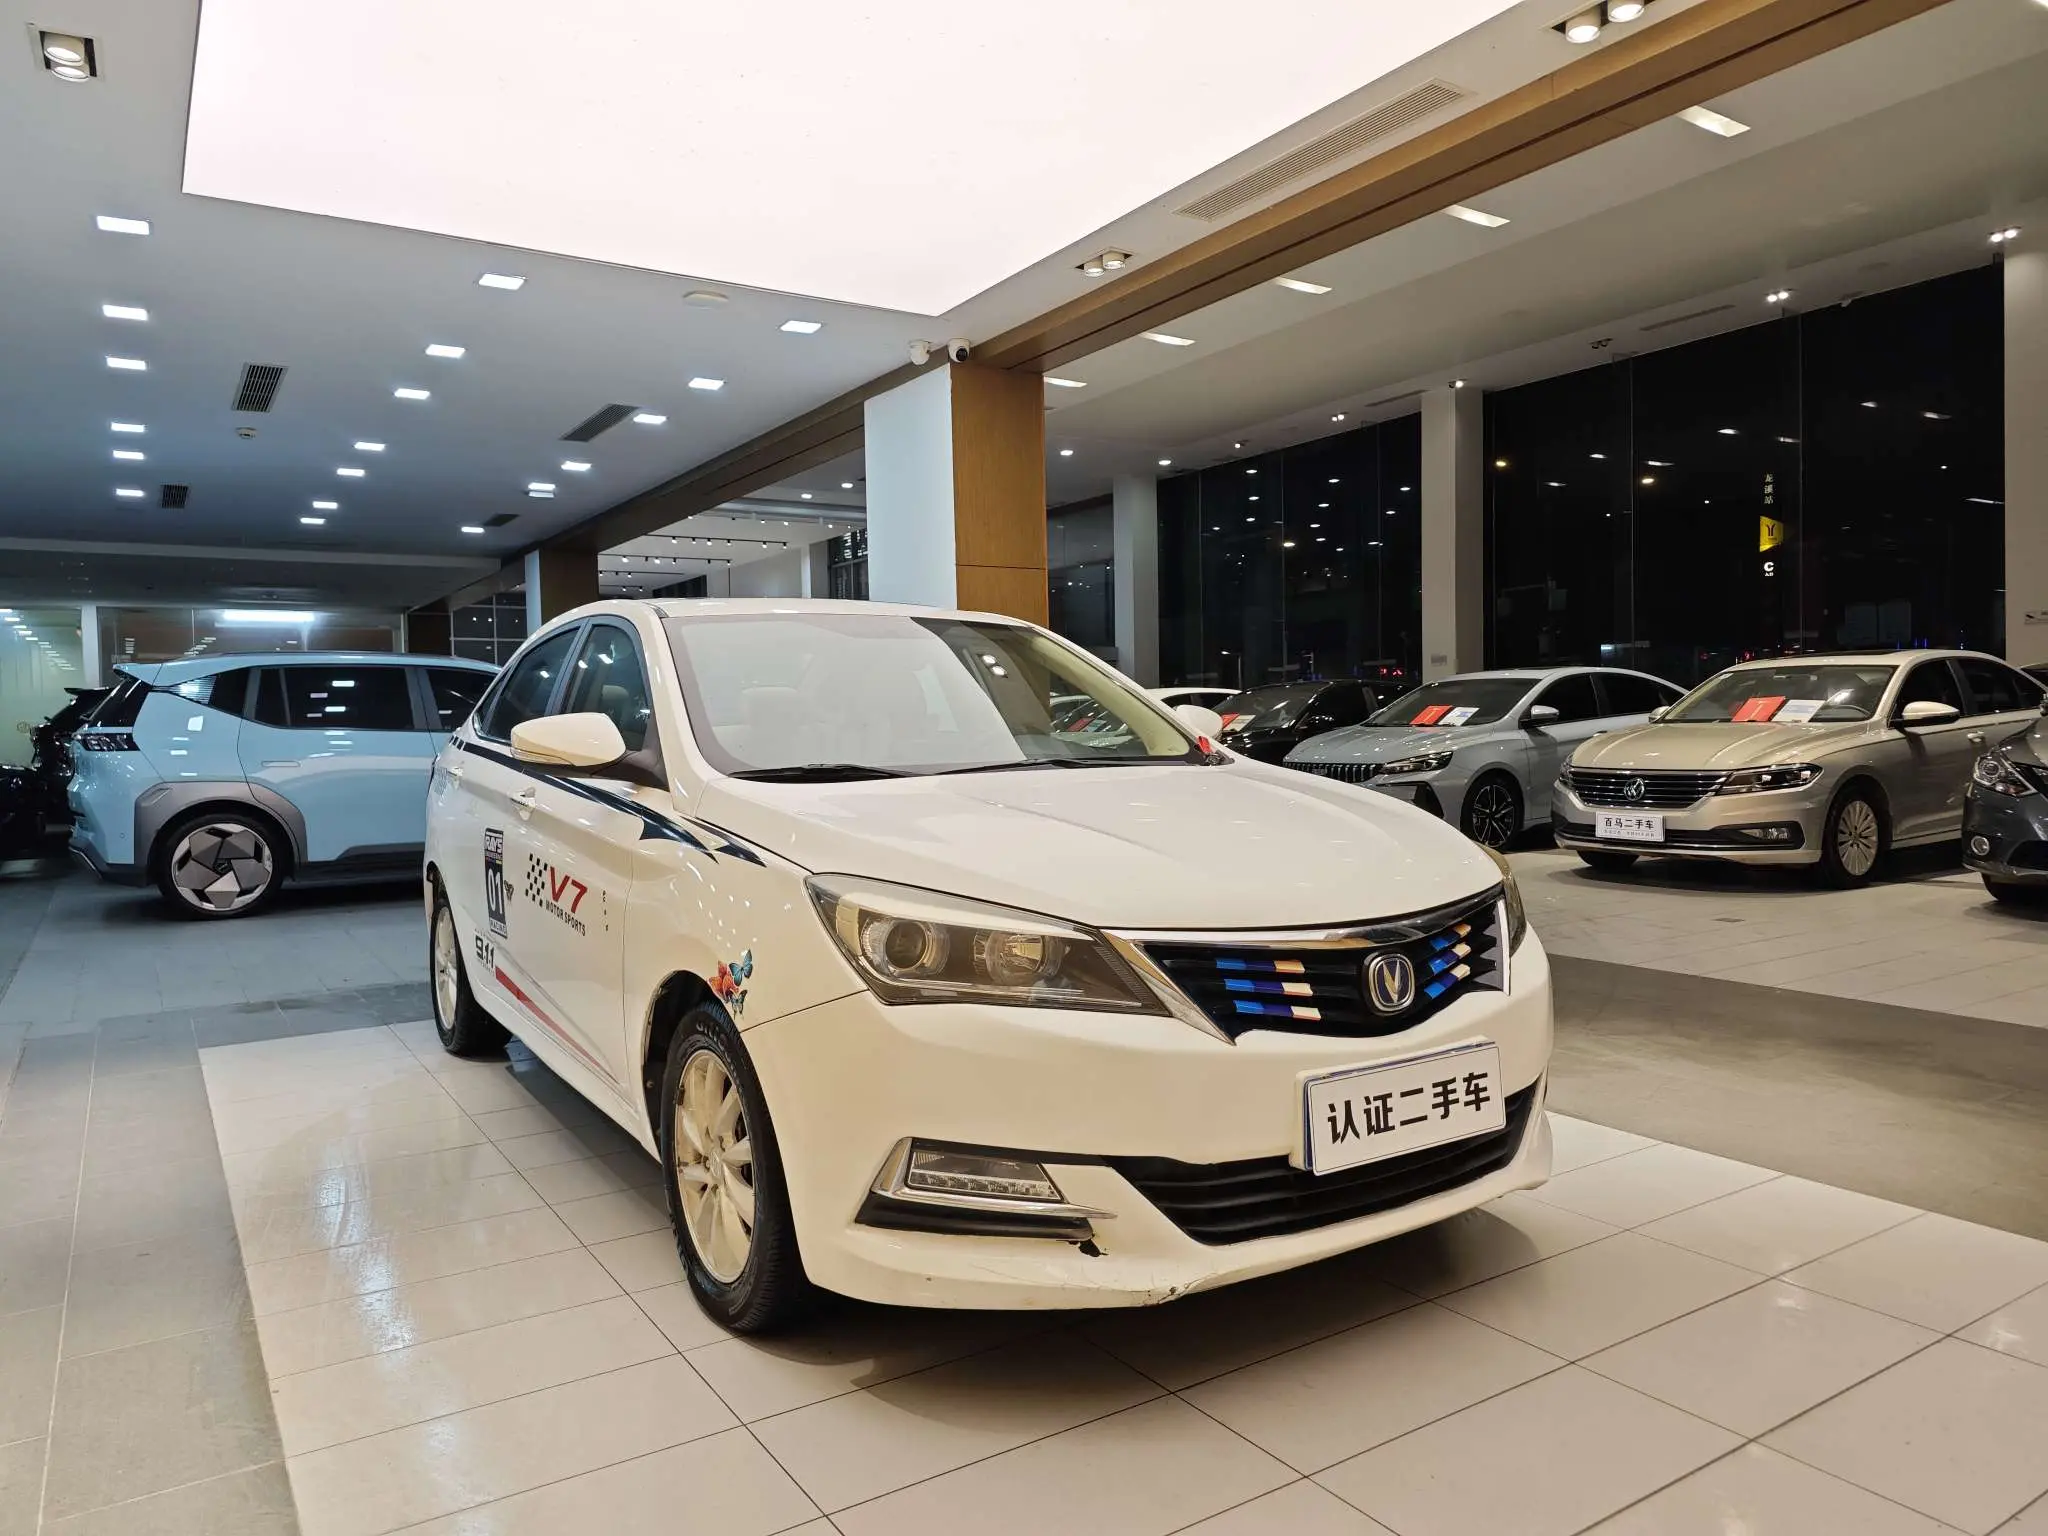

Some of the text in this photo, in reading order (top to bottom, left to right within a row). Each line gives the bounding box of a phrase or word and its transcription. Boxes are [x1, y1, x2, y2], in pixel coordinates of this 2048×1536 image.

[1764, 562, 1774, 572] C
[1604, 817, 1654, 830] 百马二手车
[485, 835, 503, 854] RAYS
[488, 868, 503, 915] 01
[550, 866, 588, 914] V7
[546, 899, 586, 937] MOTOR SPORTS
[1327, 1072, 1490, 1144] 认证二手车
